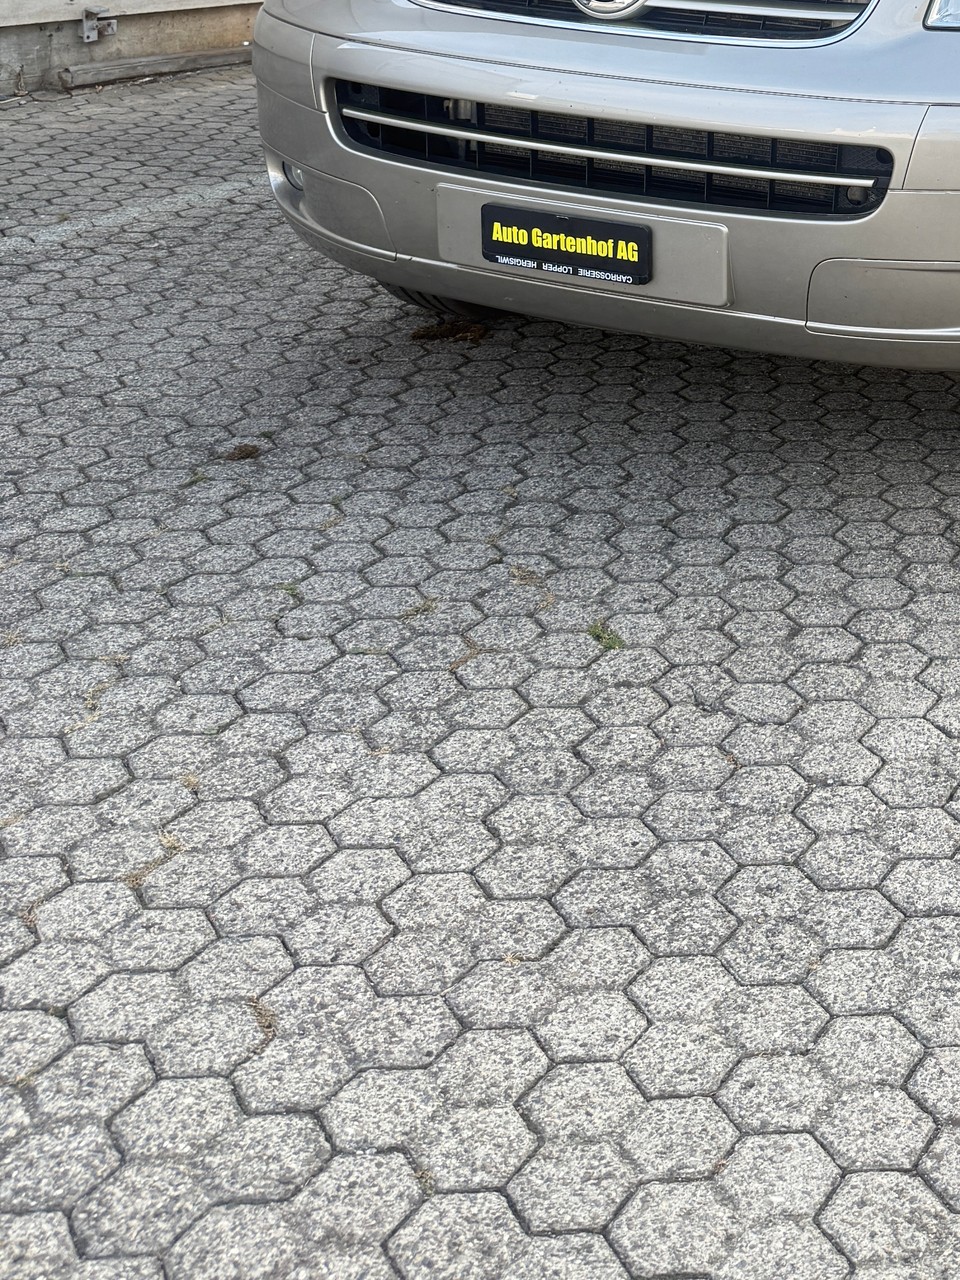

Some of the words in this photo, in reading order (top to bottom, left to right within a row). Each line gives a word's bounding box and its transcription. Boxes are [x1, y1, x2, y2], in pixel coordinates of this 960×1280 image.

[492, 222, 528, 245] Auto
[532, 227, 615, 258] Gartenhof
[616, 240, 639, 263] AG
[495, 255, 537, 269] HERGISWIL
[542, 262, 573, 275] LOPPER
[578, 268, 633, 284] CARROSSERIE
